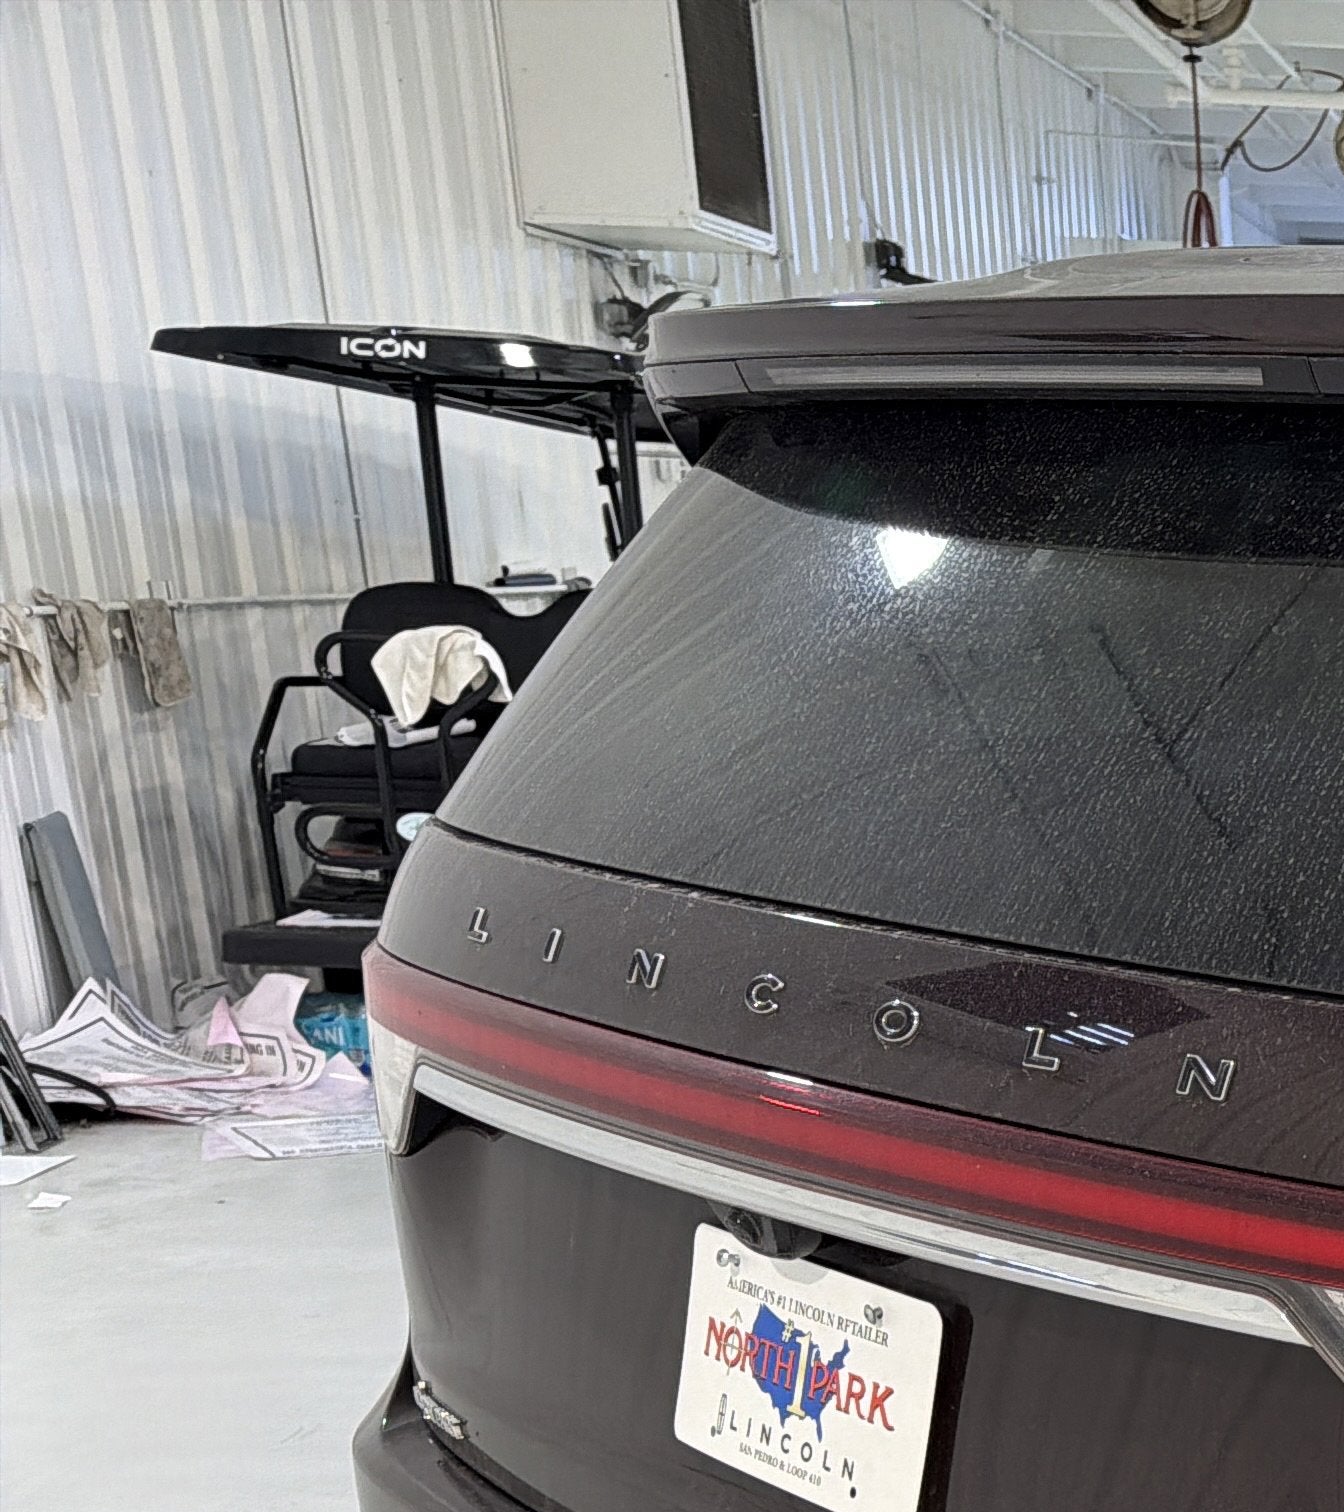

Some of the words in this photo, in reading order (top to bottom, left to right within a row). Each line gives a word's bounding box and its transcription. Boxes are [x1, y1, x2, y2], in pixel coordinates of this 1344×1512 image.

[340, 336, 426, 359] ICON
[466, 906, 1235, 1101] LINCOLN
[727, 1276, 775, 1305] AMERICA'S
[788, 1297, 835, 1328] LINCOLN
[836, 1315, 888, 1349] RETAILER
[704, 1316, 795, 1391] NORTH
[808, 1359, 894, 1431] PARK
[729, 1409, 855, 1482] LINCOLN
[754, 1448, 778, 1467] PEDRO
[779, 1460, 785, 1471] &
[786, 1462, 808, 1480] LOOP
